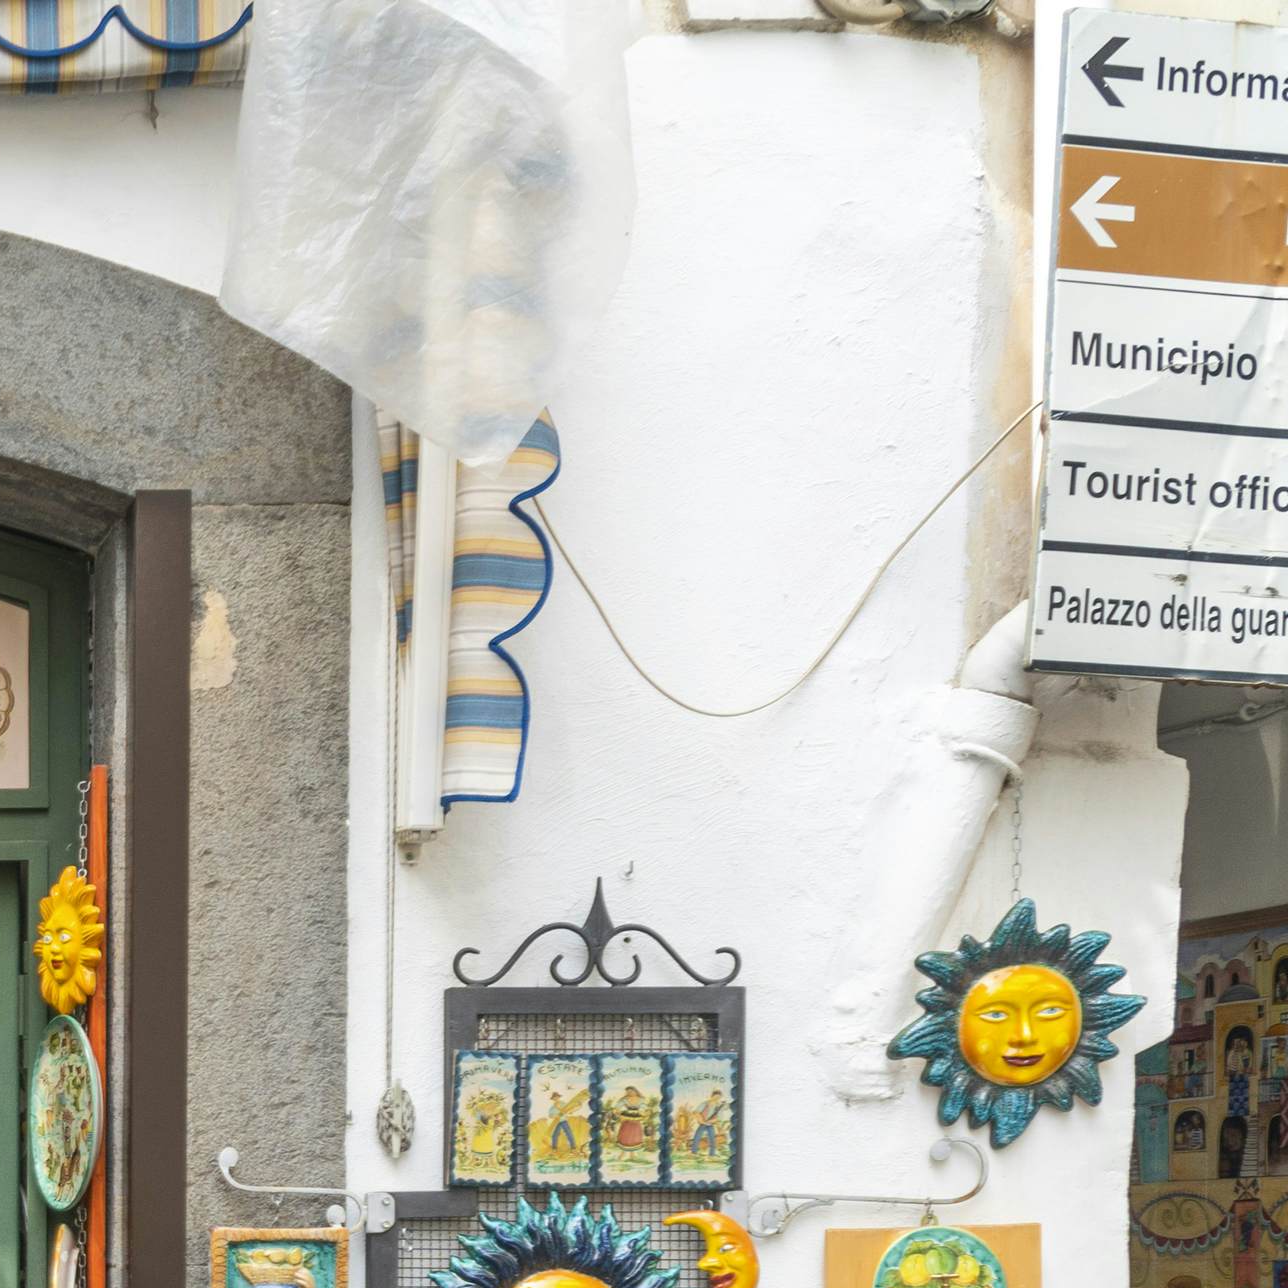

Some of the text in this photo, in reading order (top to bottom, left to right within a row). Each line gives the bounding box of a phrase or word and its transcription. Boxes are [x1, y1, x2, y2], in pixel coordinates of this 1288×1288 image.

[1156, 56, 1288, 102] Inform
[1071, 330, 1259, 386] Municipio
[1062, 460, 1197, 506] Tourist
[1047, 585, 1152, 629] Palazzo
[1159, 594, 1222, 632] della
